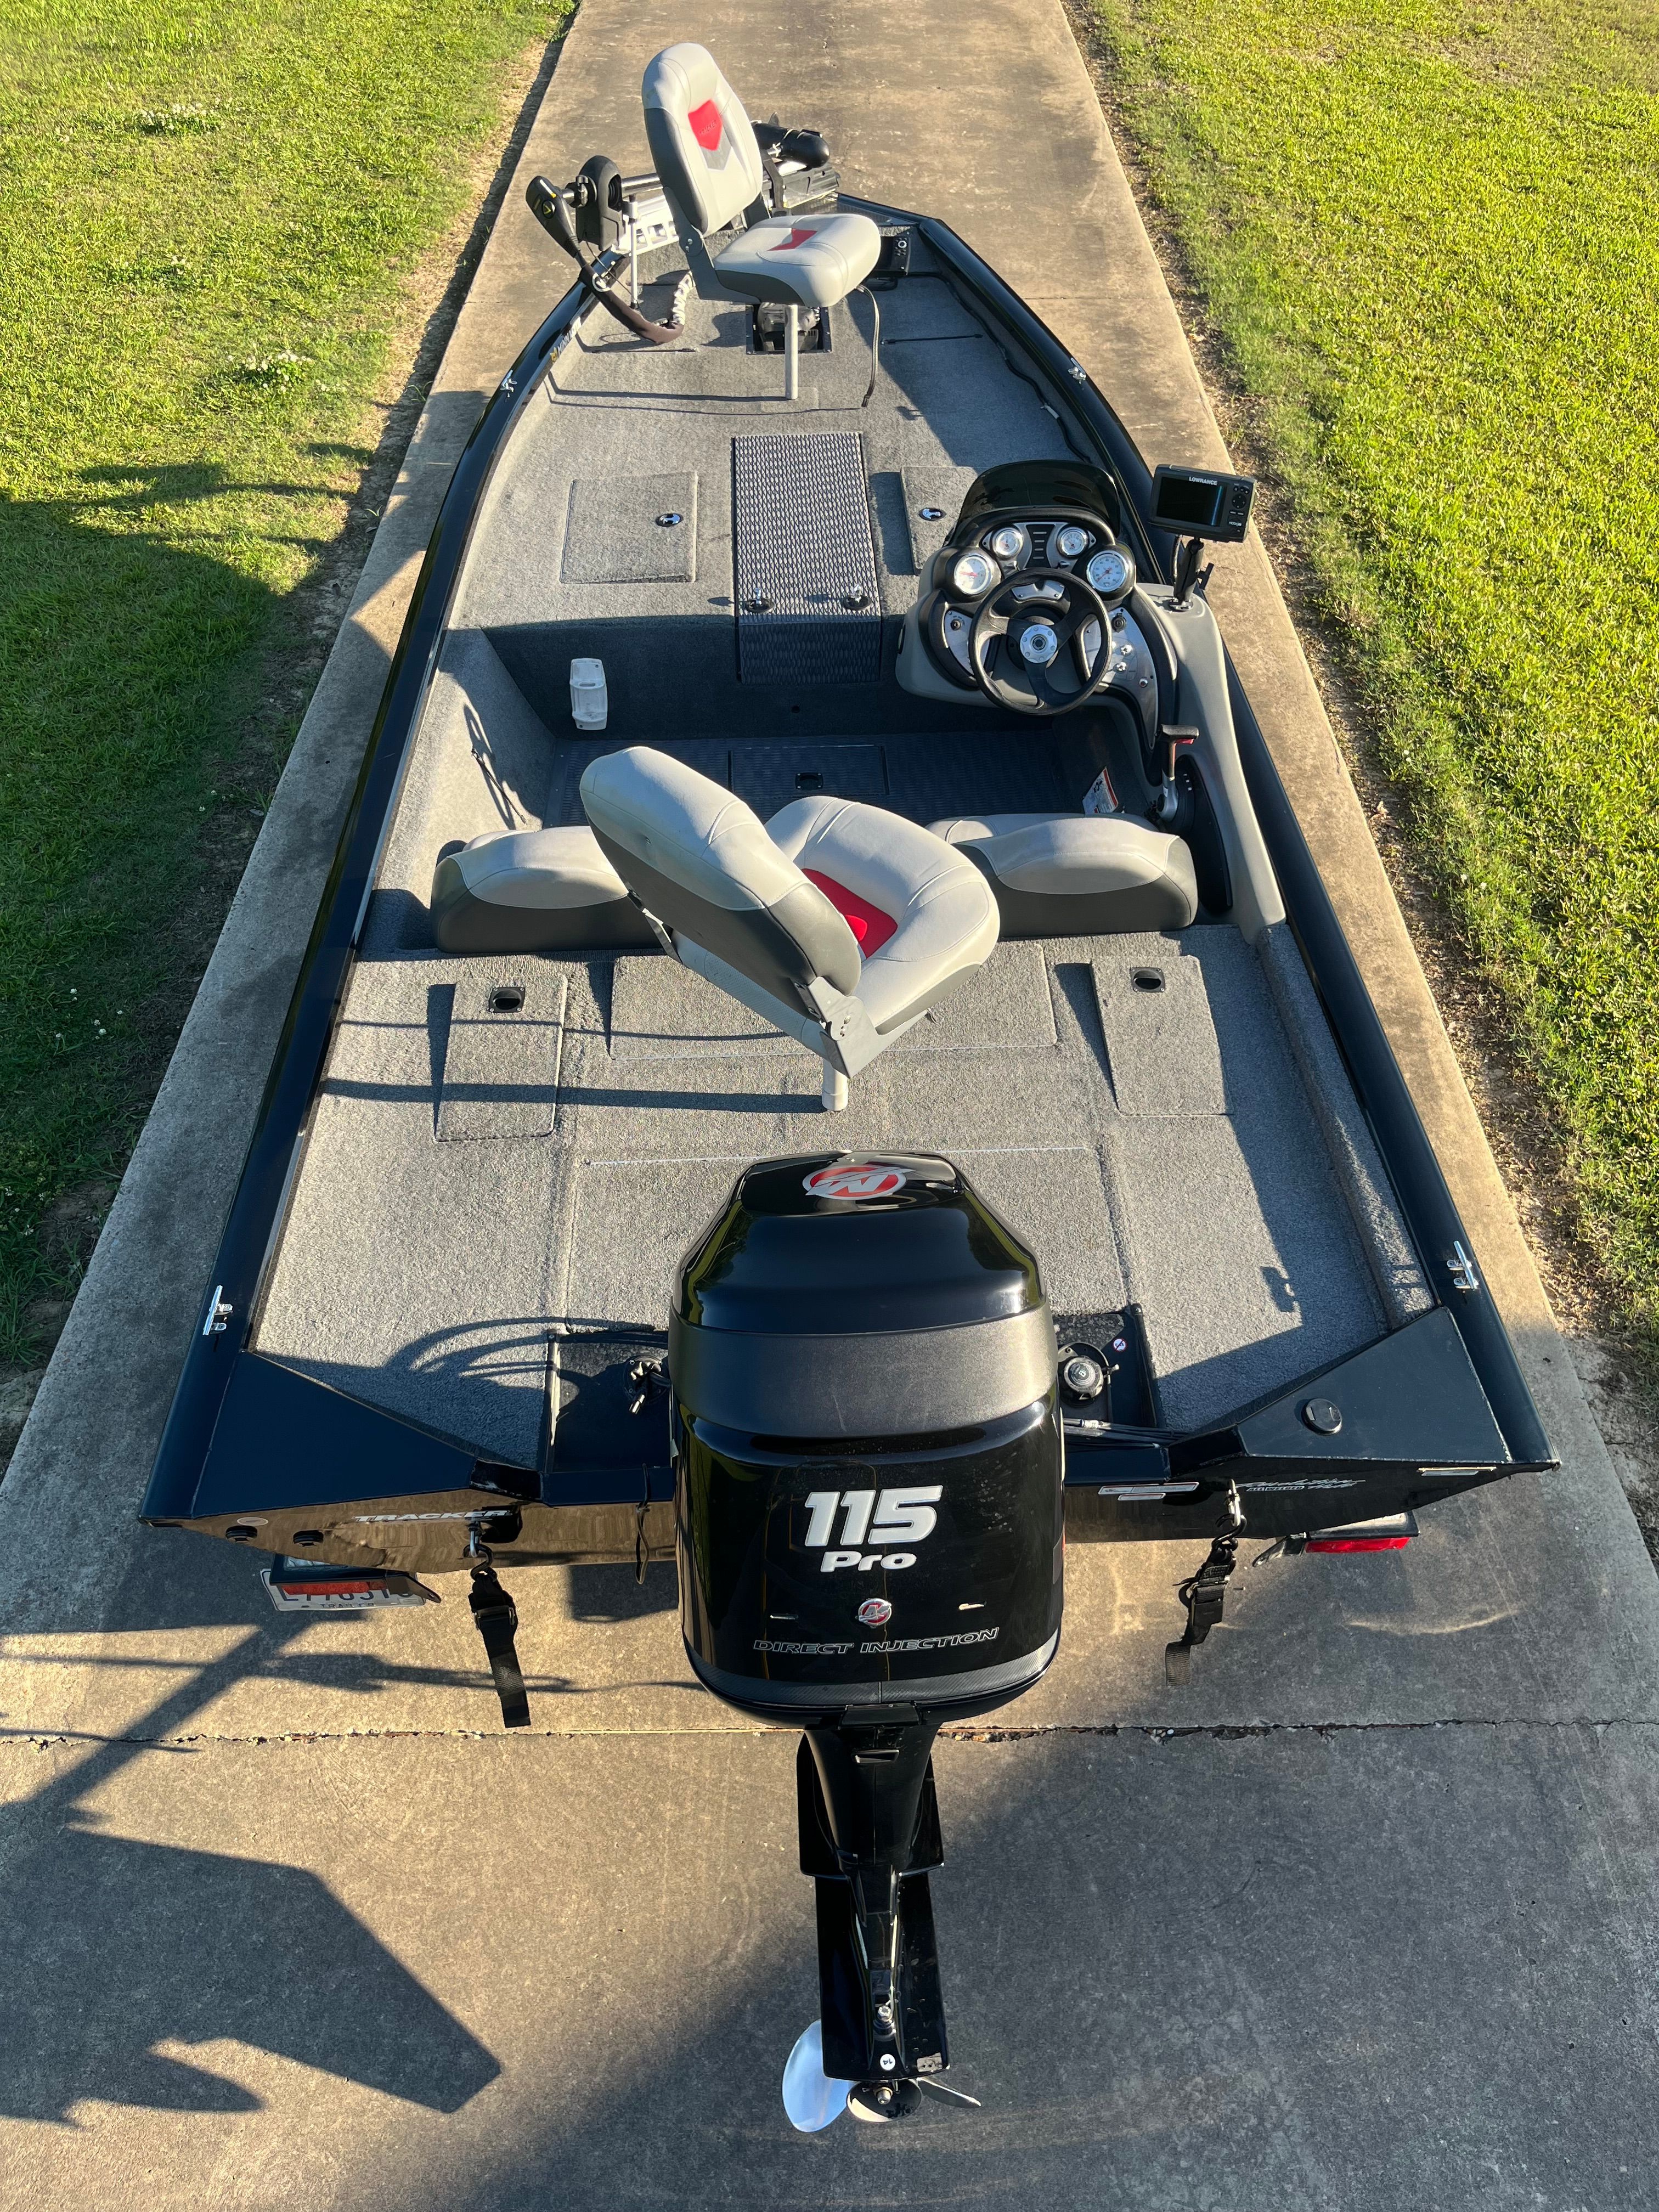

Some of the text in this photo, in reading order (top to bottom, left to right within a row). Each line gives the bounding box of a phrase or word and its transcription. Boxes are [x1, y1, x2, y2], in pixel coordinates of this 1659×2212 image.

[1189, 476, 1217, 486] LOWRANCE
[355, 1510, 513, 1522] TRACKER
[805, 1485, 943, 1546] 115
[820, 1550, 917, 1572] Pro
[753, 1627, 1000, 1654] DIRECT INJECTION
